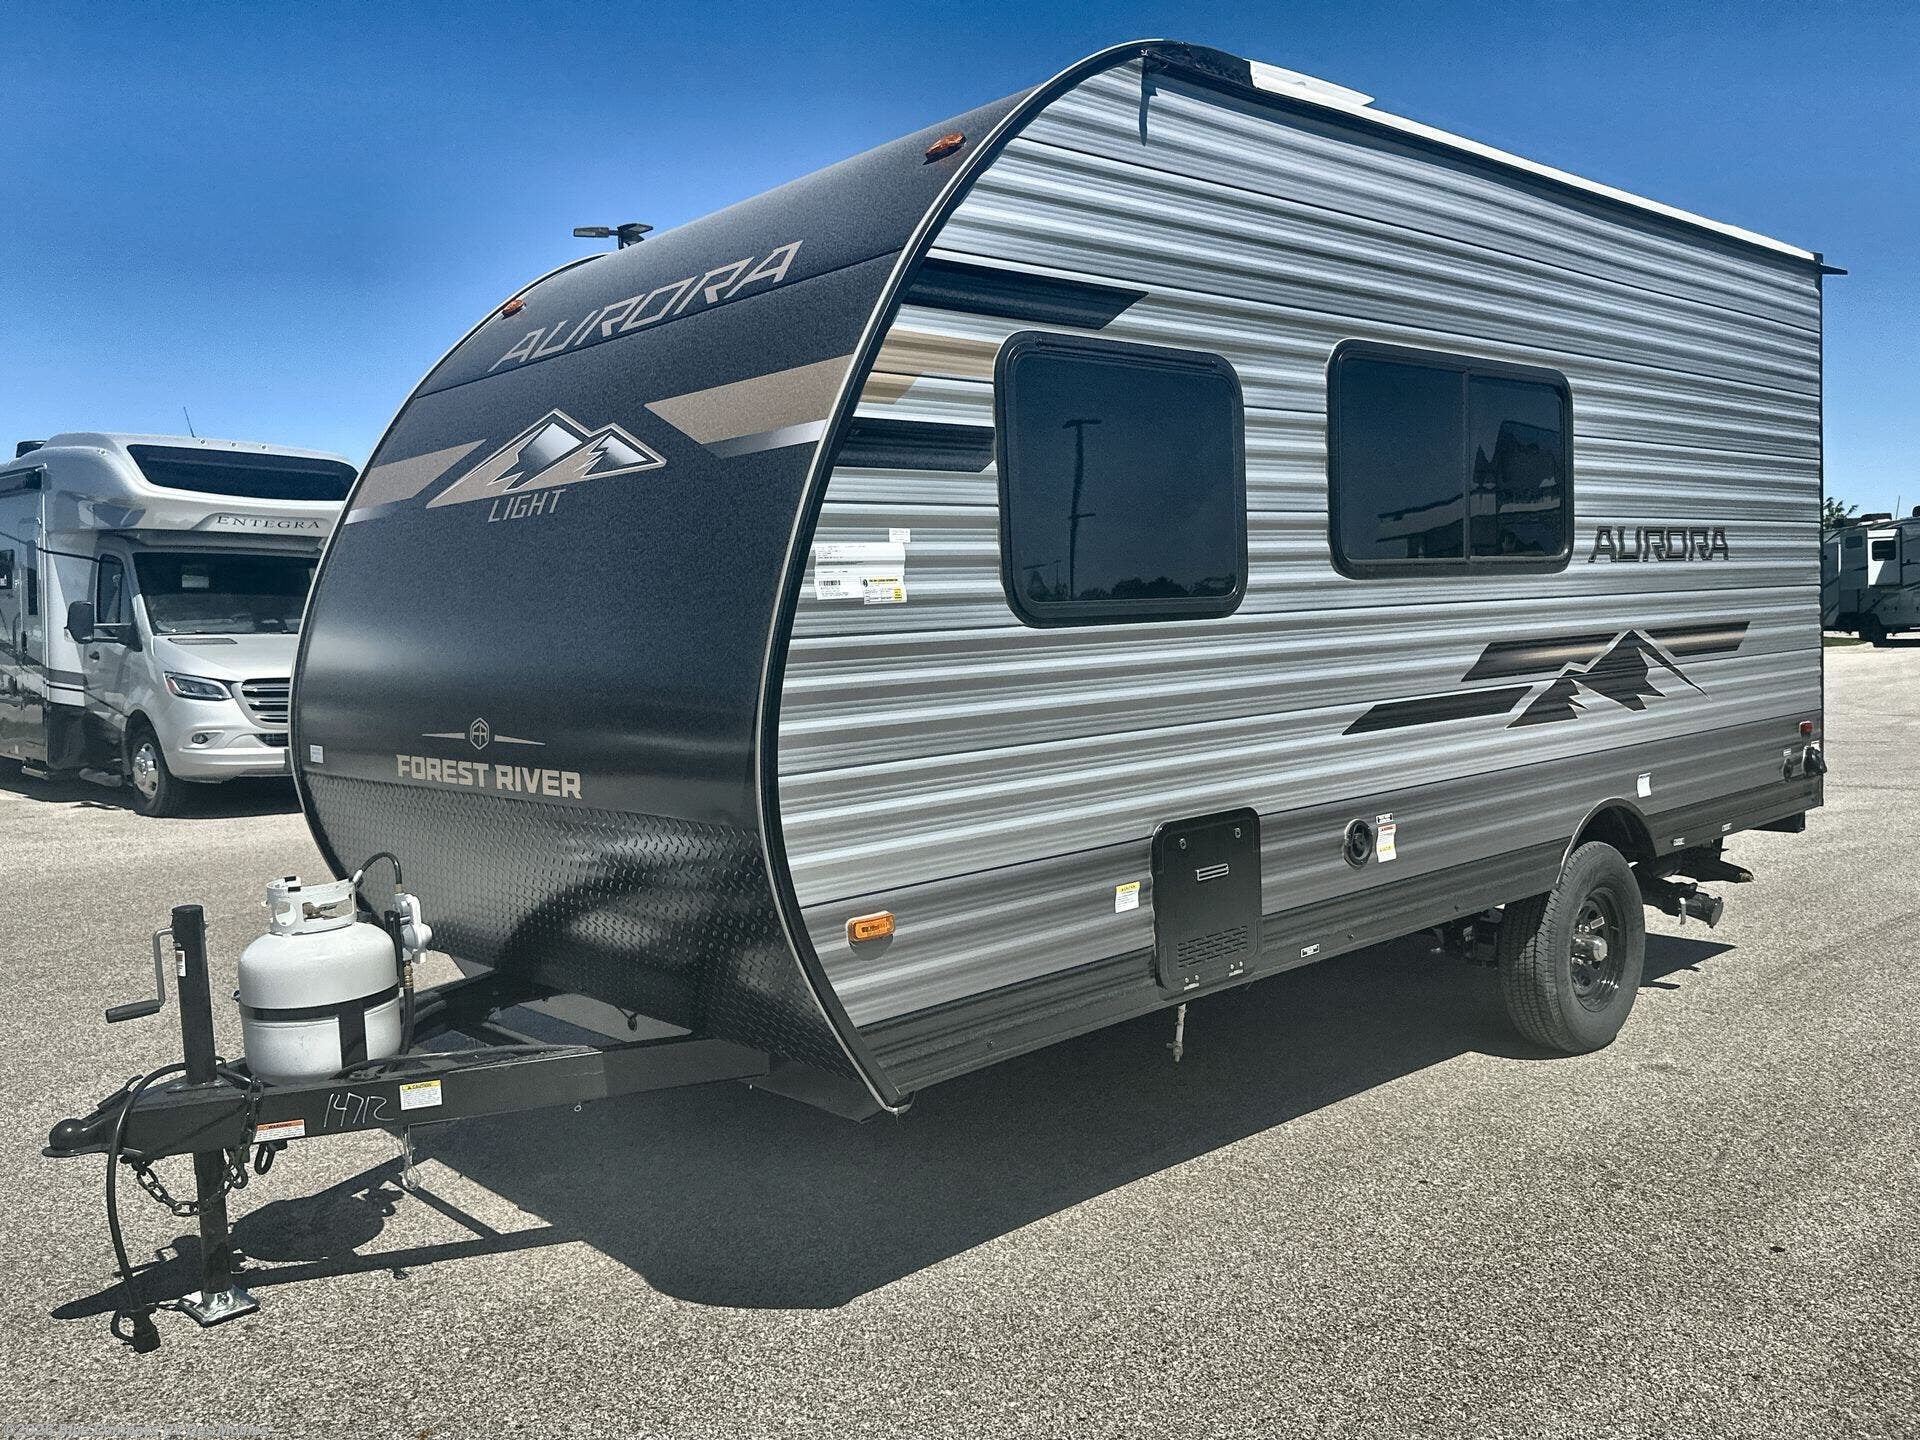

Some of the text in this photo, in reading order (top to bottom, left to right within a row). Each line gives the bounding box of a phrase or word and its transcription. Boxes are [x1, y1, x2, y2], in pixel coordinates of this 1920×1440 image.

[487, 240, 804, 374] AURORA
[216, 516, 321, 529] ENTEGRA
[487, 489, 567, 523] LIGHT
[1588, 525, 1729, 563] AURORA
[396, 754, 583, 800] FOREST RIVER
